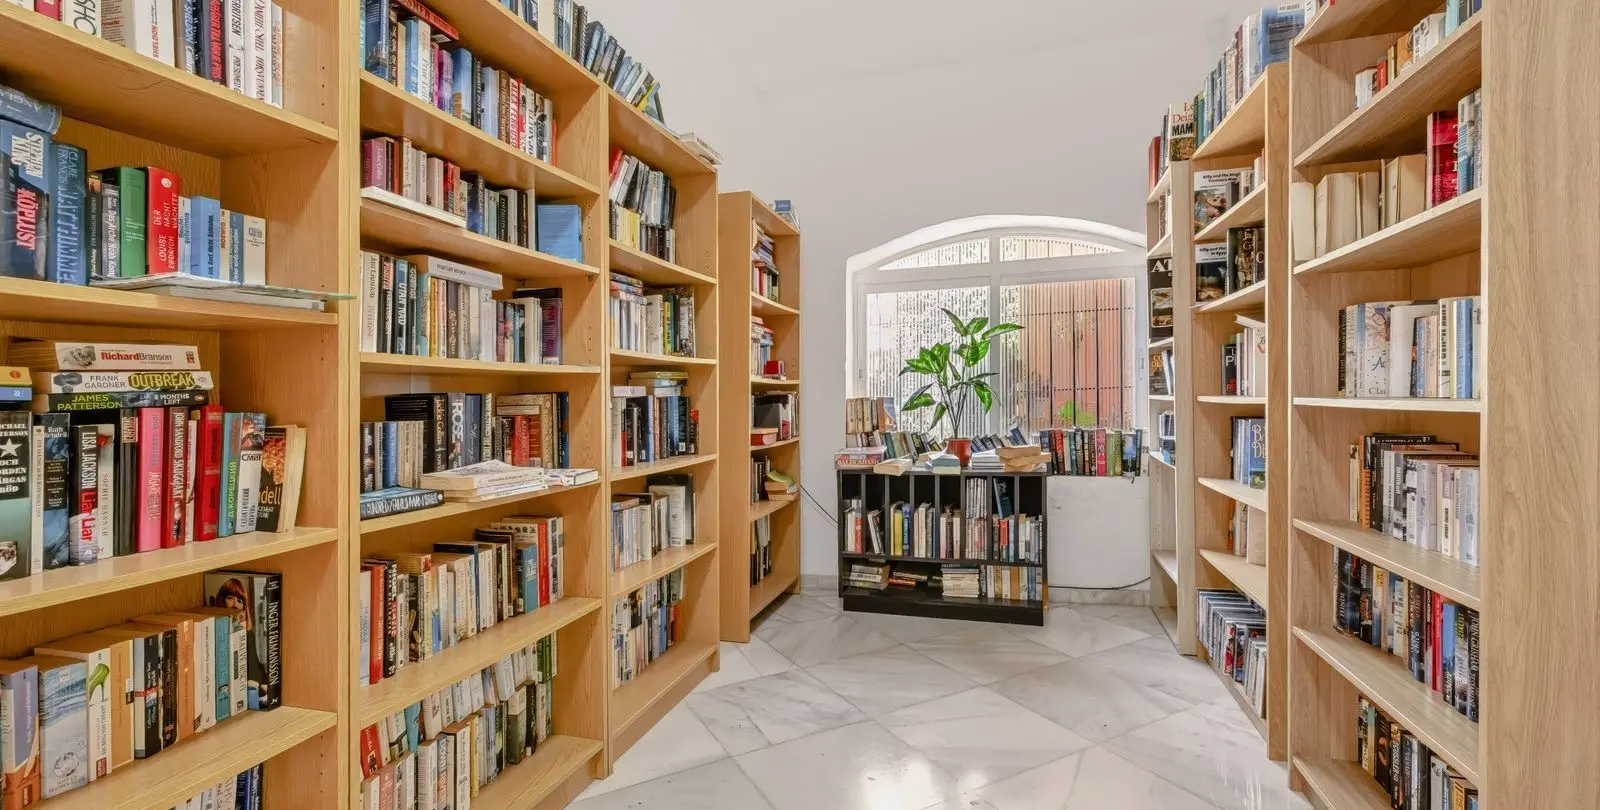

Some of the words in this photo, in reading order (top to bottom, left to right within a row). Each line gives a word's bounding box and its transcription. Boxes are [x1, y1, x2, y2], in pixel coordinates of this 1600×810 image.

[510, 81, 519, 104] ALEX
[11, 135, 31, 166] KING
[26, 132, 43, 178] STEPHEN
[58, 148, 69, 184] FRANCIS
[69, 151, 79, 179] CLARE
[16, 187, 38, 250] KÖPLUST
[153, 210, 162, 225] DER
[158, 234, 167, 262] LOUISE
[168, 236, 176, 269] ERDRICH
[369, 269, 378, 298] Guillou
[398, 283, 407, 305] UTAN
[85, 381, 126, 389] GARDNER
[131, 372, 195, 389] OUTBREAK
[57, 401, 124, 411] PATTERSON
[72, 394, 109, 403] JAMES
[435, 398, 444, 421] Jackie
[173, 412, 184, 427] JOHN
[451, 402, 464, 442] ROSE
[81, 432, 93, 450] LISA
[173, 427, 184, 458] SANDFORD
[81, 451, 97, 489] JACKSON
[81, 491, 97, 515] Liar
[258, 486, 281, 505] dell
[81, 517, 96, 542] Liar
[268, 601, 280, 628] INGER
[1471, 616, 1479, 636] JOHN
[238, 634, 246, 664] MAEVE
[268, 630, 281, 686] FRIMANSSON
[1470, 637, 1480, 671] GRISHAM
